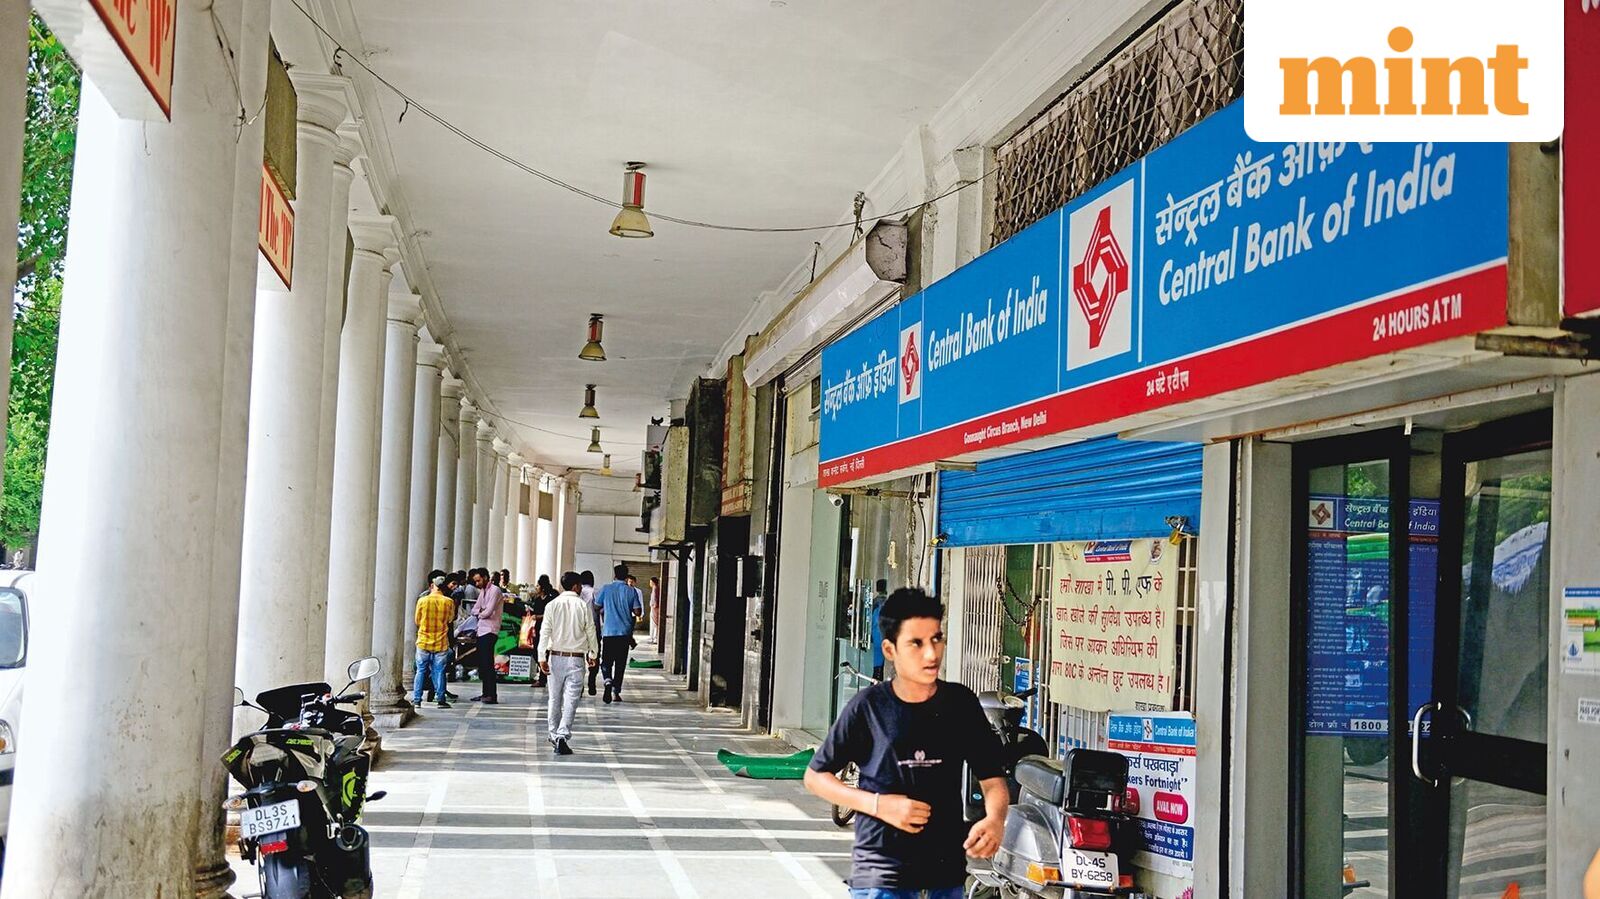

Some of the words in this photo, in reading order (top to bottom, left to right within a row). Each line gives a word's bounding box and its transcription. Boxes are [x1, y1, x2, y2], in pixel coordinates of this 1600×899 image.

[1155, 179, 1224, 247] सेन्ट्रल
[1226, 150, 1275, 208] बैंक
[1158, 226, 1239, 306] Central
[1244, 196, 1316, 274] Bank
[1322, 172, 1358, 243] of
[1364, 142, 1456, 228] India
[928, 312, 964, 372] Central
[965, 298, 995, 356] Bank
[997, 288, 1012, 342] of
[1013, 275, 1048, 336] India
[1373, 314, 1386, 342] 24
[1388, 302, 1430, 336] HOURS
[874, 349, 897, 399] इंडिया
[1146, 380, 1154, 397] 24
[987, 425, 1001, 439] Circus
[1021, 416, 1032, 429] New
[1033, 410, 1047, 427] Delhi
[1413, 505, 1437, 517] इंडिया
[1344, 518, 1375, 528] Central
[1377, 519, 1389, 529] Ba
[1414, 522, 1436, 531] India
[1075, 580, 1094, 595] शाखा
[1106, 570, 1116, 596] पी.
[1136, 576, 1152, 598] एफ
[1154, 571, 1163, 592] के
[1088, 604, 1098, 625] की
[1101, 605, 1120, 632] सुविधा
[1075, 637, 1084, 652] पर
[1147, 635, 1158, 659] की
[1079, 660, 1084, 680] के
[1113, 671, 1124, 692] छूट
[1127, 672, 1155, 690] उपलब्ध
[1155, 725, 1167, 736] Central
[1168, 726, 1177, 736] Bank
[1178, 726, 1182, 736] of
[1183, 725, 1194, 737] India
[1354, 721, 1382, 730] 1800
[255, 804, 287, 821] DL3S
[1156, 800, 1170, 813] AVAIL
[1170, 803, 1183, 816] NOW
[249, 814, 296, 834] BS9741
[1076, 855, 1106, 868] DL-4S
[1071, 869, 1113, 882] BY-6258
